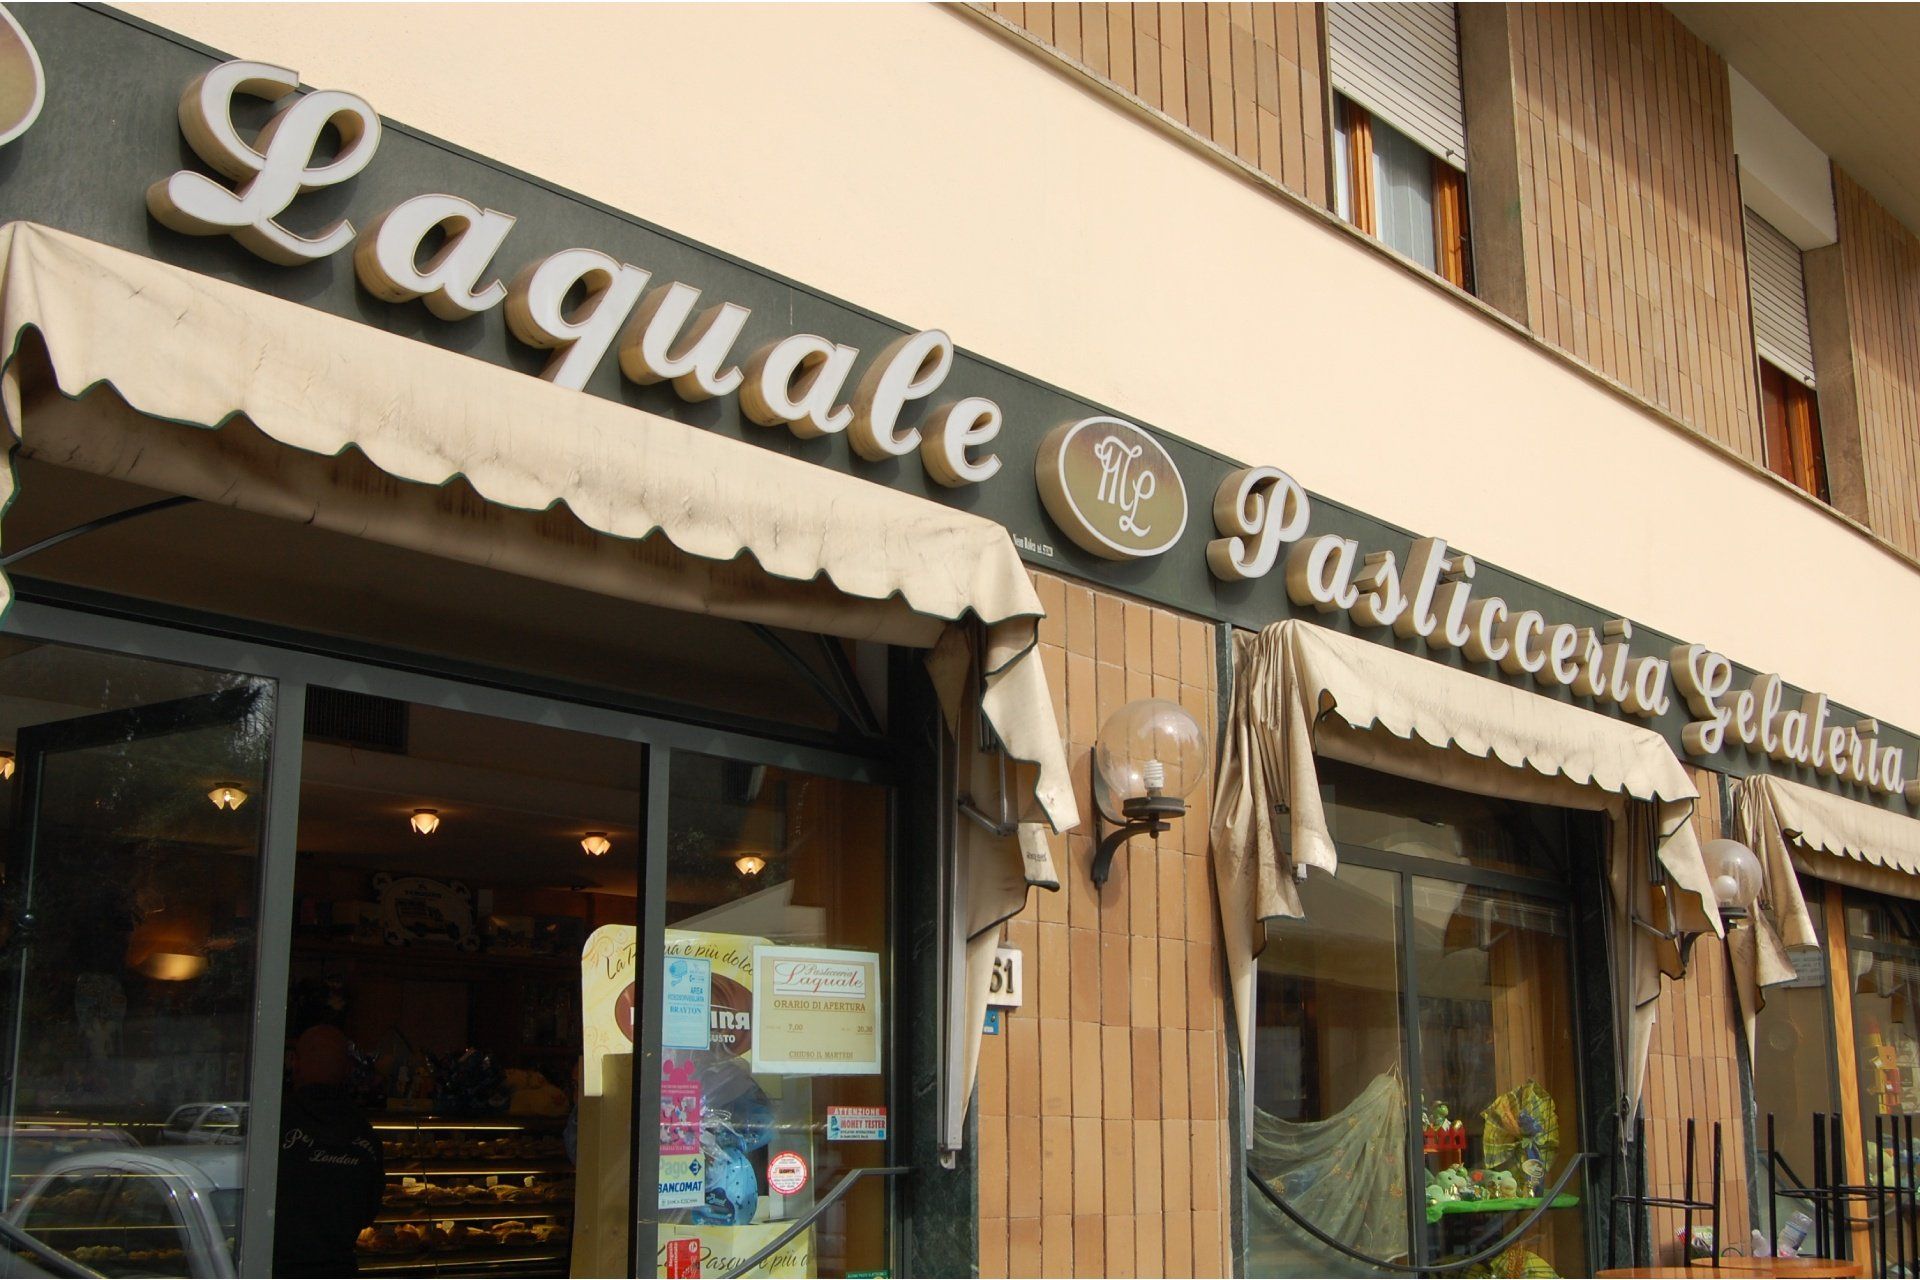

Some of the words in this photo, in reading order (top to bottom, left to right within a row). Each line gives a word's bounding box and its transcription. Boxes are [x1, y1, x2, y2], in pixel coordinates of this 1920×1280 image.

[165, 58, 1002, 483] Laquale
[1222, 465, 1670, 716] Pasticceria
[1684, 643, 1905, 794] Gelateria
[774, 962, 864, 993] Laquale
[773, 1000, 810, 1010] ORARIO
[812, 1000, 821, 1010] DI
[823, 1001, 866, 1012] APERTURA
[788, 1051, 815, 1059] CHIUSO
[834, 1107, 880, 1115] ATTENZIONE
[840, 1120, 863, 1129] MONEY
[864, 1120, 886, 1129] TESTER
[309, 1150, 360, 1165] London
[658, 1181, 703, 1194] BANCOMAT
